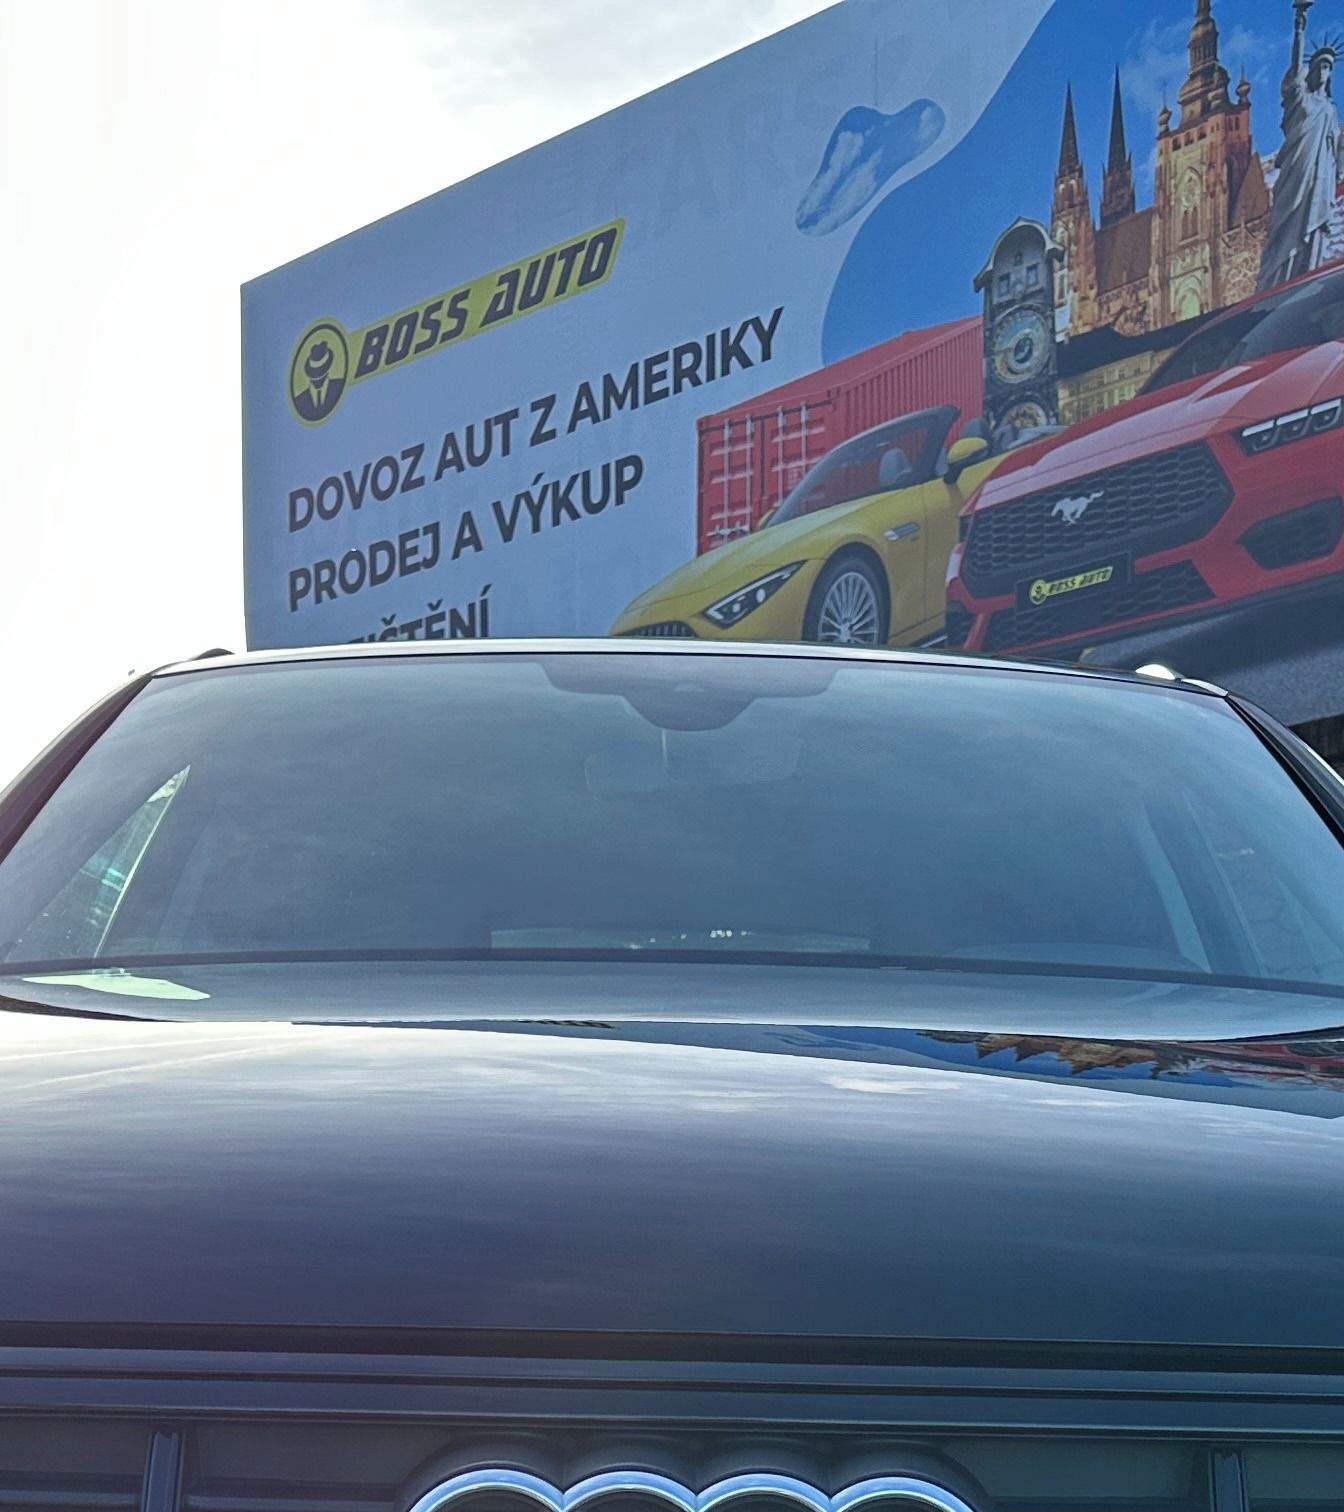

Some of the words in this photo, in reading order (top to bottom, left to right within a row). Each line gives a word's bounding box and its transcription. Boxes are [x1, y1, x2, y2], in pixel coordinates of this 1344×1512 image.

[355, 289, 471, 379] BOSS
[478, 226, 619, 328] AUTO
[288, 442, 426, 533] DOVOZ
[433, 408, 519, 483] AUT
[529, 393, 557, 448] Z
[567, 306, 785, 436] AMERIKY
[288, 528, 441, 613] PRODEJ
[452, 510, 483, 560] A
[492, 454, 644, 544] VÝKUP
